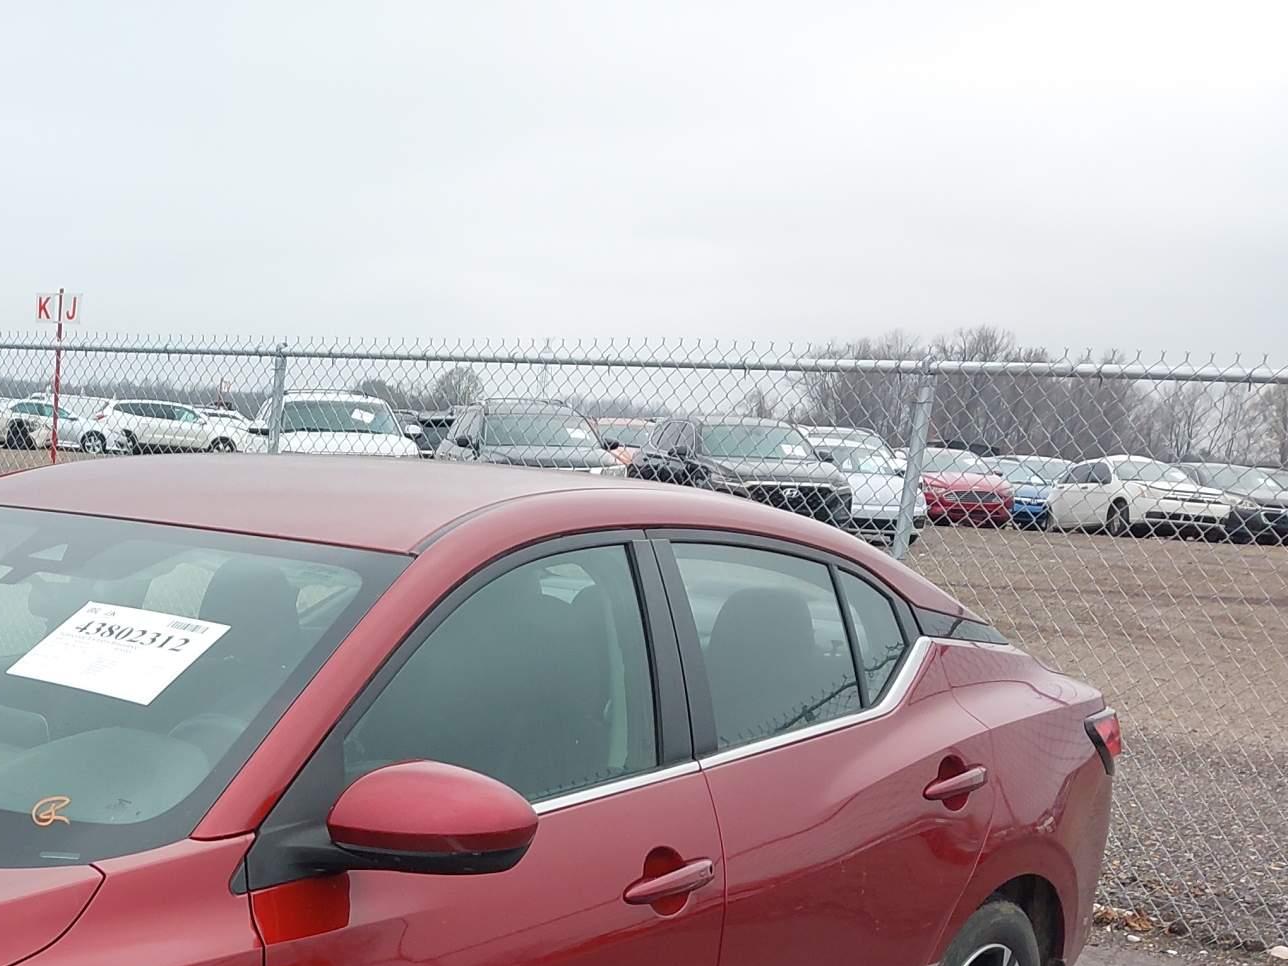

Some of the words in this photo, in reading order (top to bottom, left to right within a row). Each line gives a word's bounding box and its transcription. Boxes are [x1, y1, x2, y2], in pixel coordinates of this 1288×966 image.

[38, 296, 51, 319] K
[66, 296, 77, 320] J
[75, 621, 190, 652] 43802312
